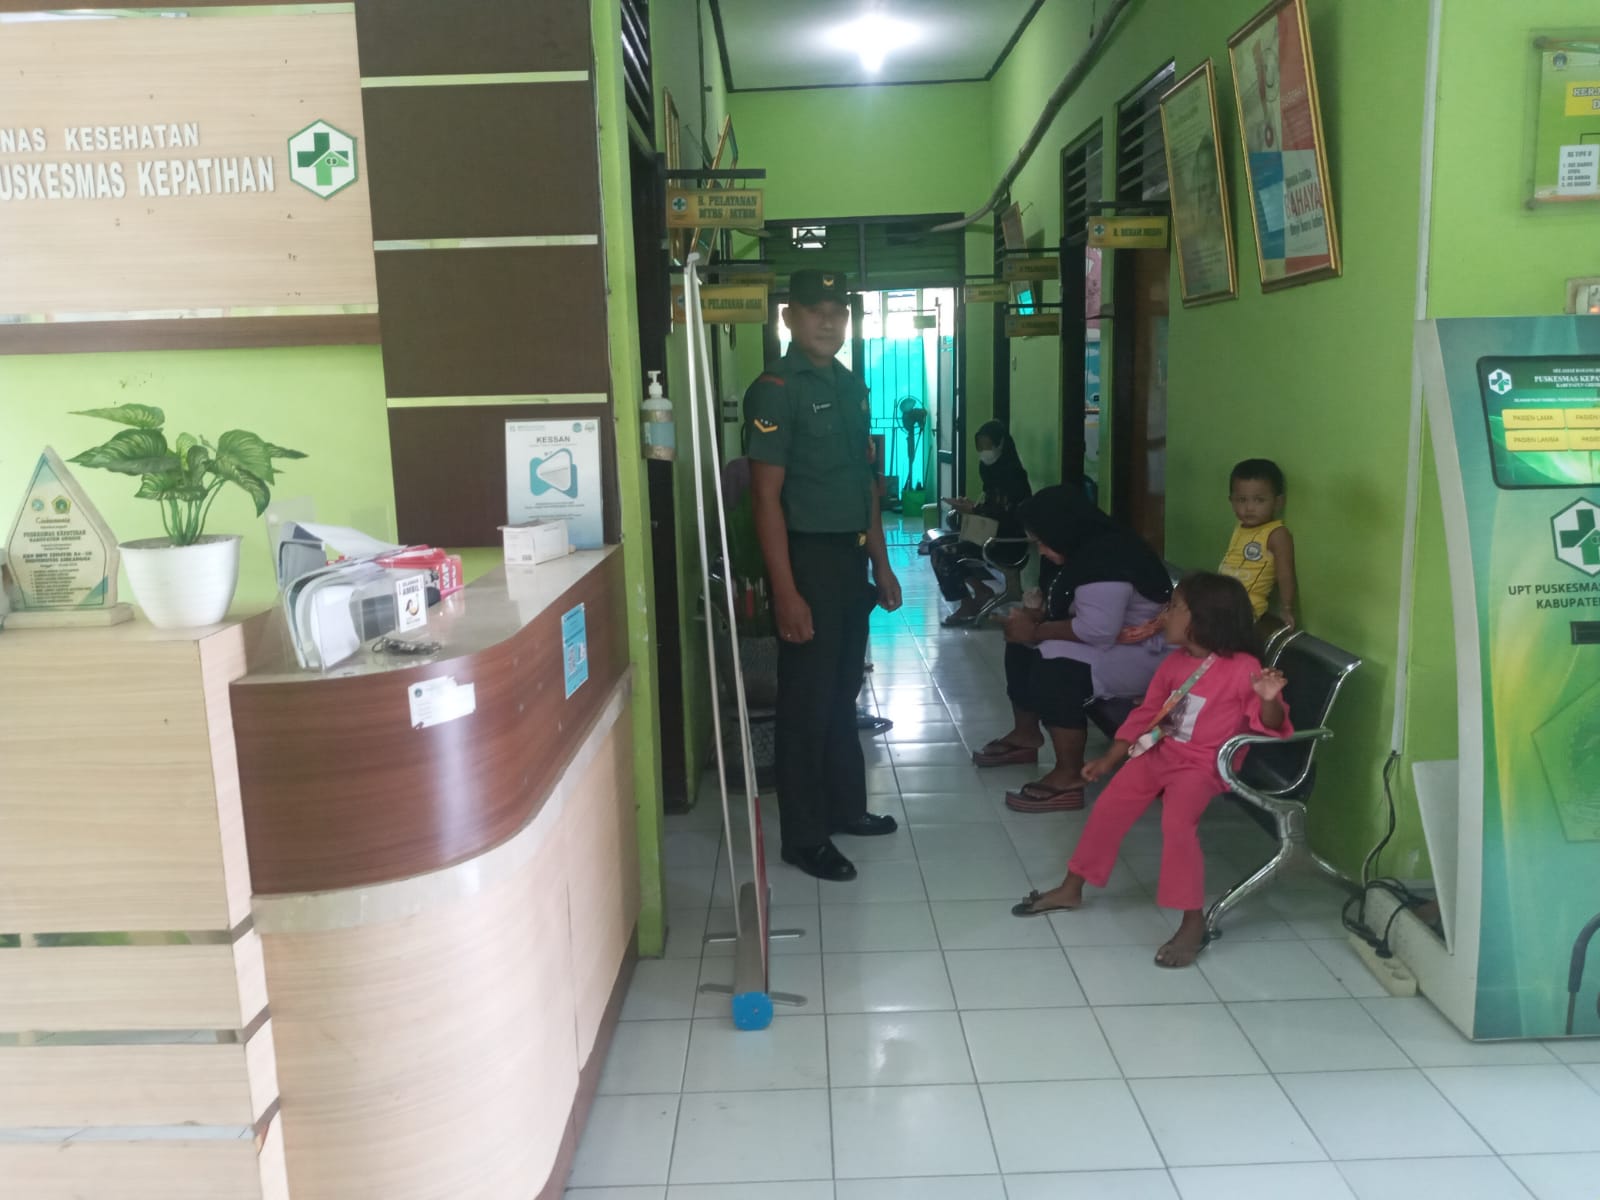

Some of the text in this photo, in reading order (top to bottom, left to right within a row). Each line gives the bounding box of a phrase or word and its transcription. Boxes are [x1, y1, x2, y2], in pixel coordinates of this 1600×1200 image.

[0, 123, 199, 152] NAS KESEHATAN
[0, 156, 275, 200] USKESMAS KEPATIHAN
[709, 195, 757, 206] PELAYANAN
[1534, 375, 1579, 383] PUSKESMAS
[536, 435, 571, 444] KESSAN
[1508, 584, 1532, 596] UPT
[1536, 597, 1600, 609] KABUPATE
